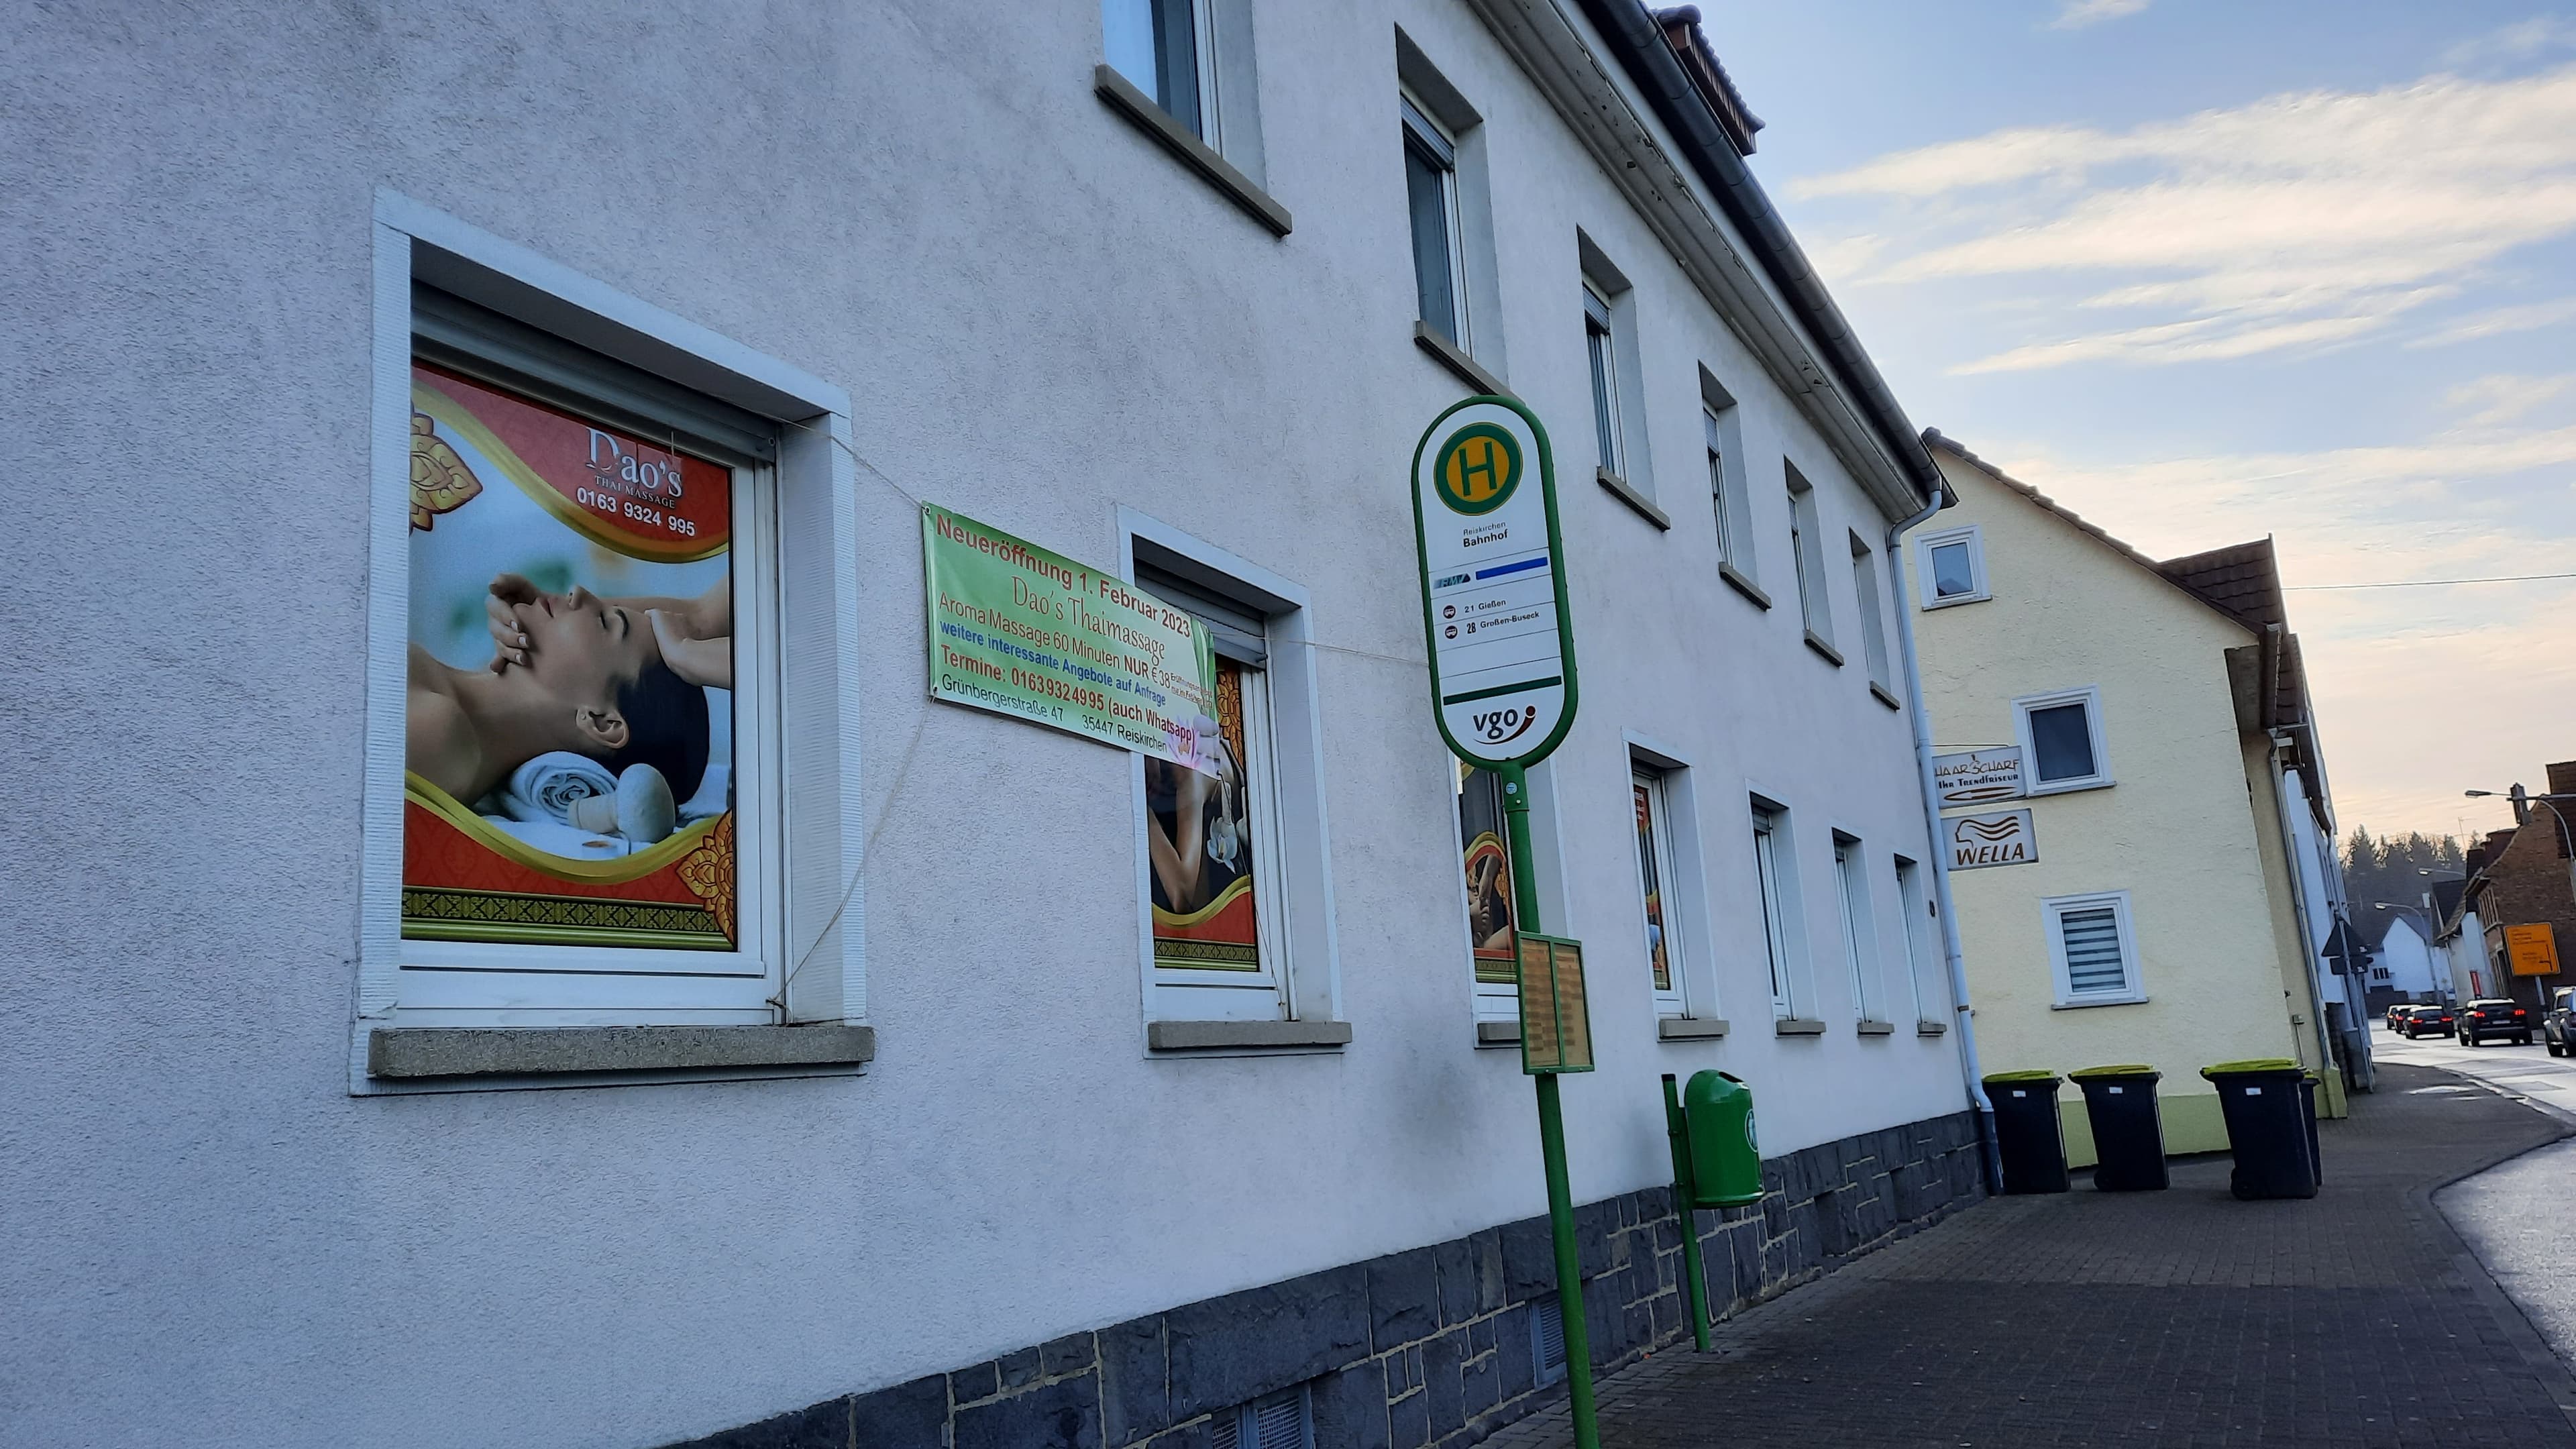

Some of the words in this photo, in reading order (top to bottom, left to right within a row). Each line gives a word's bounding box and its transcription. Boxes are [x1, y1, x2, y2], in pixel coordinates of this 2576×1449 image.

[586, 427, 682, 497] Dao's
[1458, 441, 1497, 496] H
[576, 487, 617, 513] 0163
[624, 502, 661, 526] 9324
[668, 516, 696, 537] 995
[594, 474, 621, 492] THAI
[625, 484, 676, 508] MASSAGE
[1463, 521, 1506, 536] Reiskirchen
[1463, 529, 1509, 547] Bahnhof
[936, 514, 1073, 590] Neueröffnung
[1079, 572, 1093, 594] 1.
[1100, 580, 1158, 621] Februar
[1162, 609, 1191, 638] 2023
[939, 592, 985, 624] Aroma
[989, 608, 1051, 648] Massage
[1053, 631, 1069, 652] 60
[1073, 637, 1120, 669] Minuten
[1124, 655, 1149, 680] NUR
[1068, 596, 1165, 666] Thaimassage
[1466, 622, 1477, 635] 28
[940, 621, 984, 646] weitere
[988, 634, 1059, 669] interessante
[1063, 658, 1113, 687] Angebote
[1116, 678, 1132, 691] auf
[1134, 683, 1166, 708] Anfrage
[941, 644, 1006, 682] Termine:
[1108, 697, 1143, 722] (auch
[1146, 708, 1196, 745] Whatsapp)
[942, 674, 1048, 718] Grünbergerstraße
[1051, 705, 1063, 722] 47
[1081, 714, 1114, 736] 35447
[1118, 724, 1167, 753] Reiskirchen
[1473, 708, 1519, 740] vgo
[1957, 843, 2025, 865] WELLA
